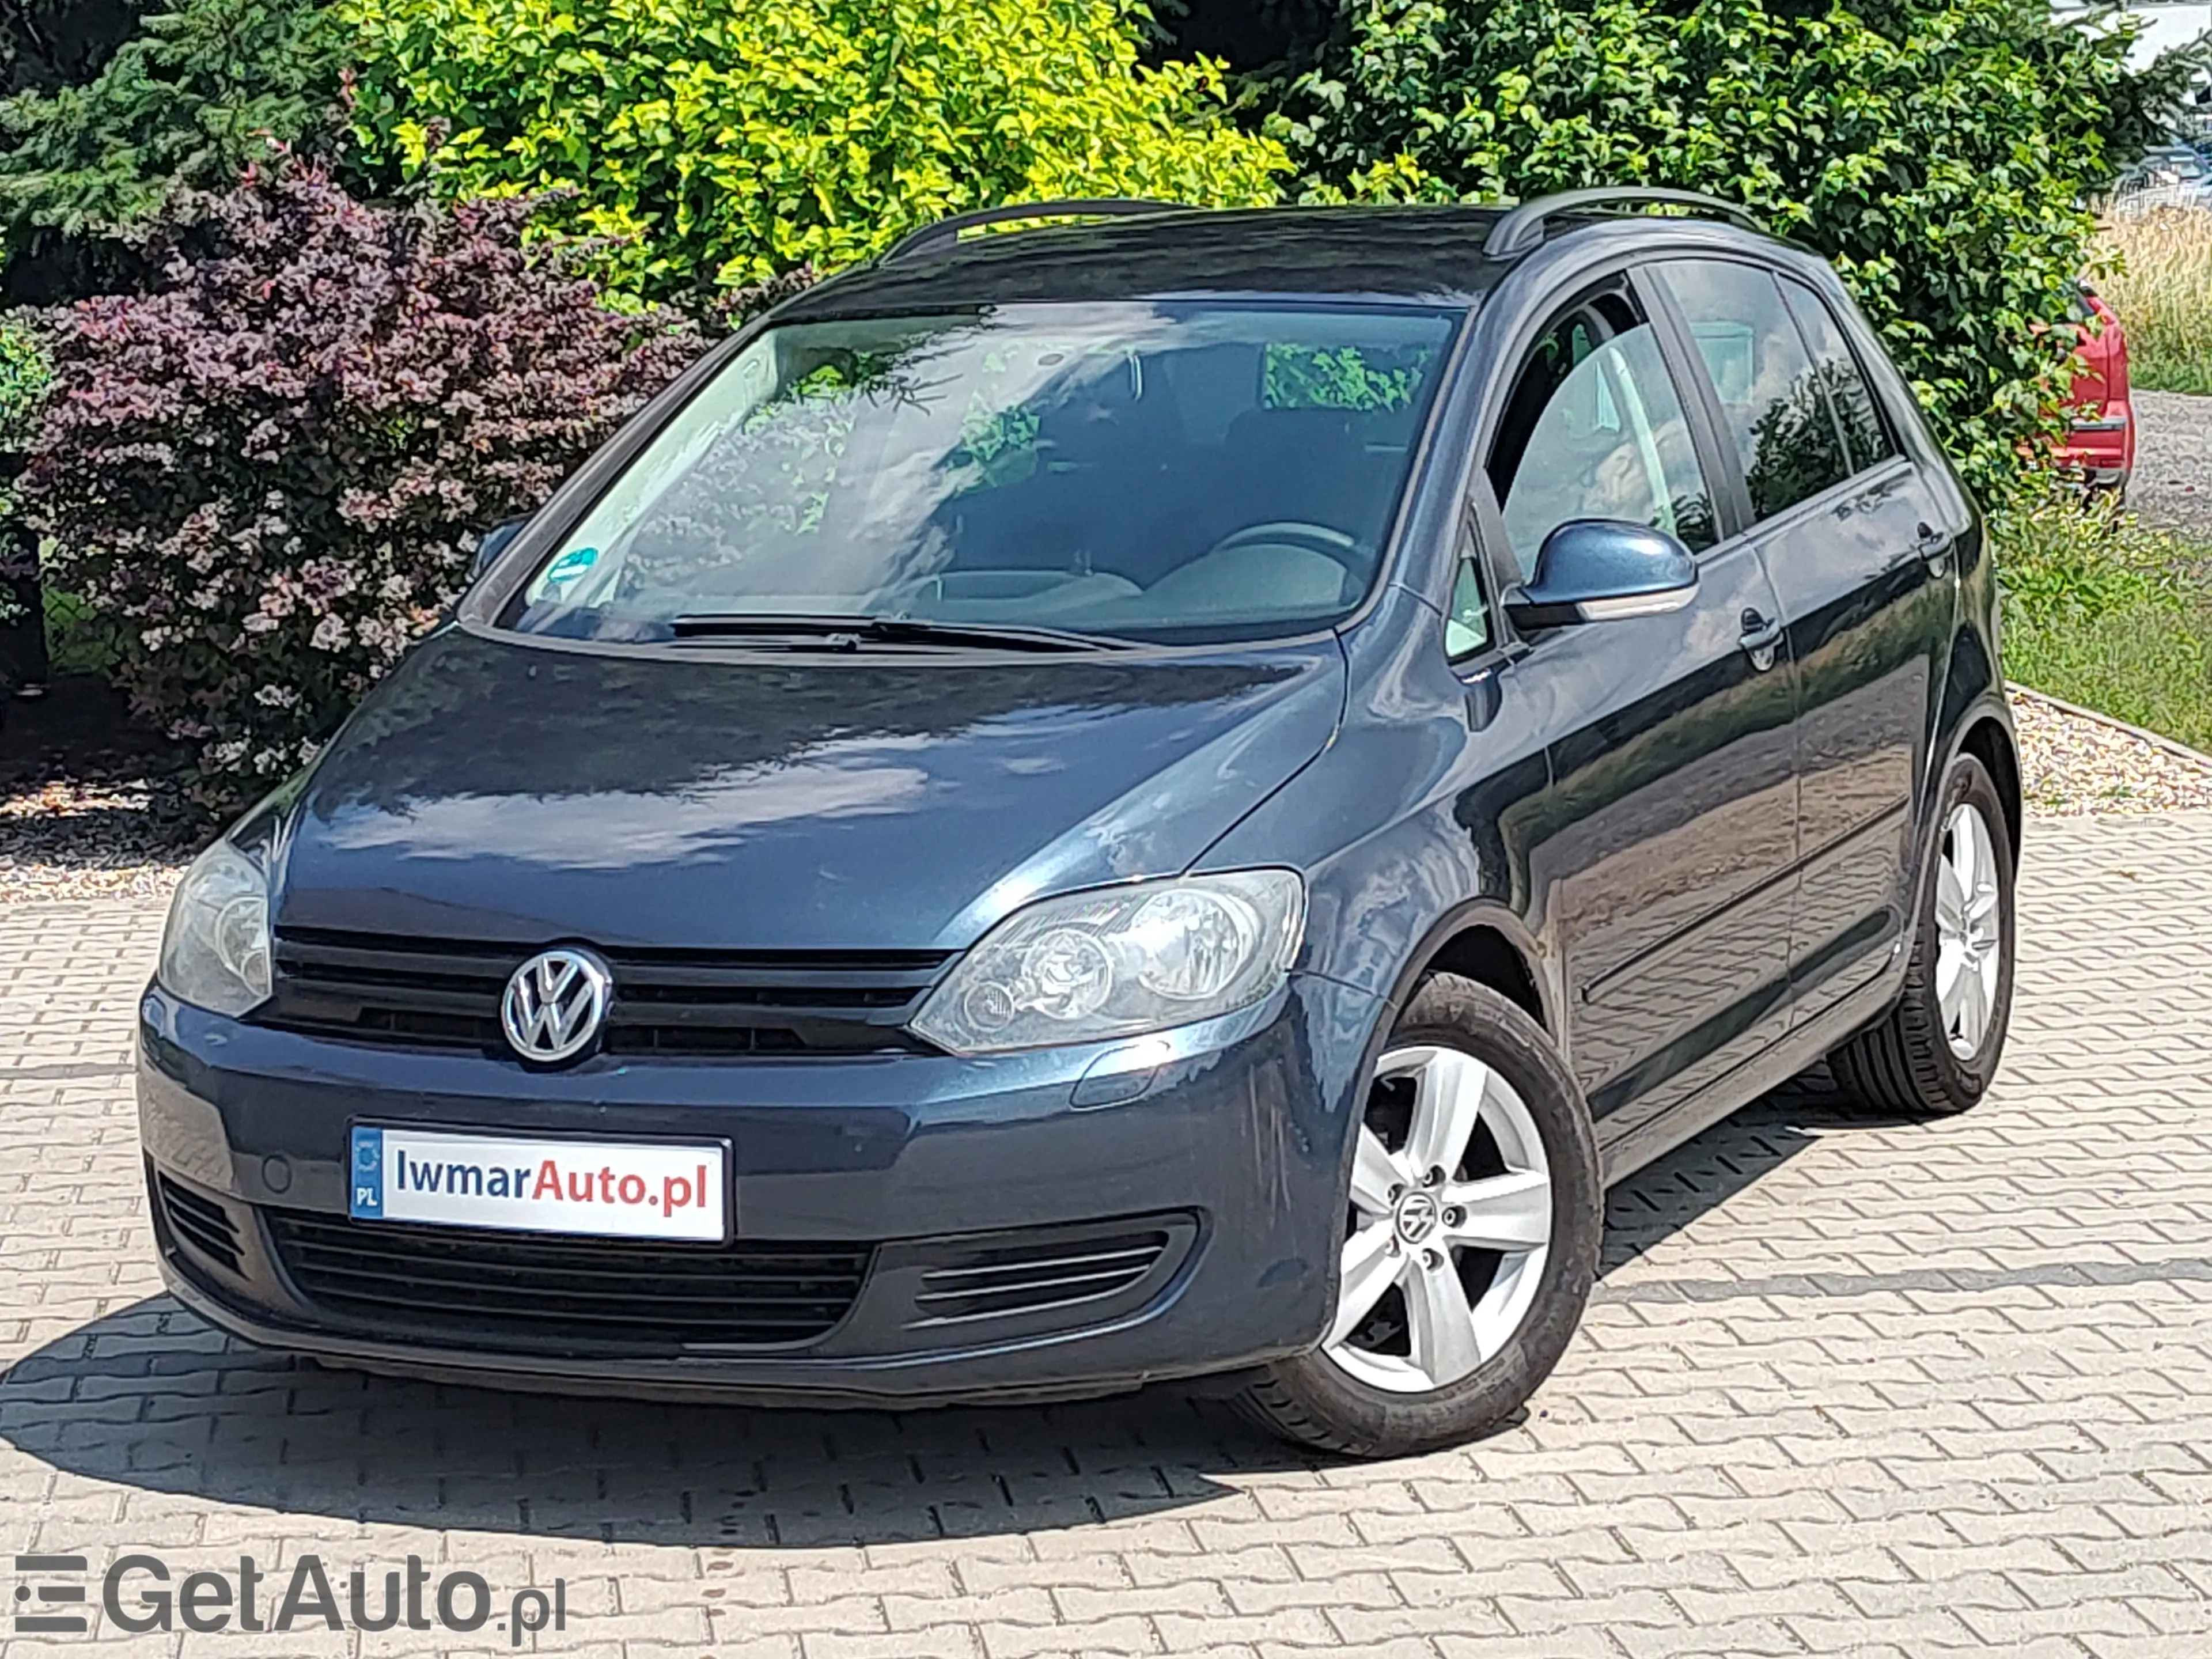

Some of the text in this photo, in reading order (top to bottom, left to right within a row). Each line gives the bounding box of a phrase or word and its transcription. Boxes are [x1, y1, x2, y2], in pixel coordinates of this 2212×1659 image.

[508, 953, 598, 1055] VW
[356, 1187, 378, 1206] PL
[397, 1149, 707, 1217] IwmarAuto.pl
